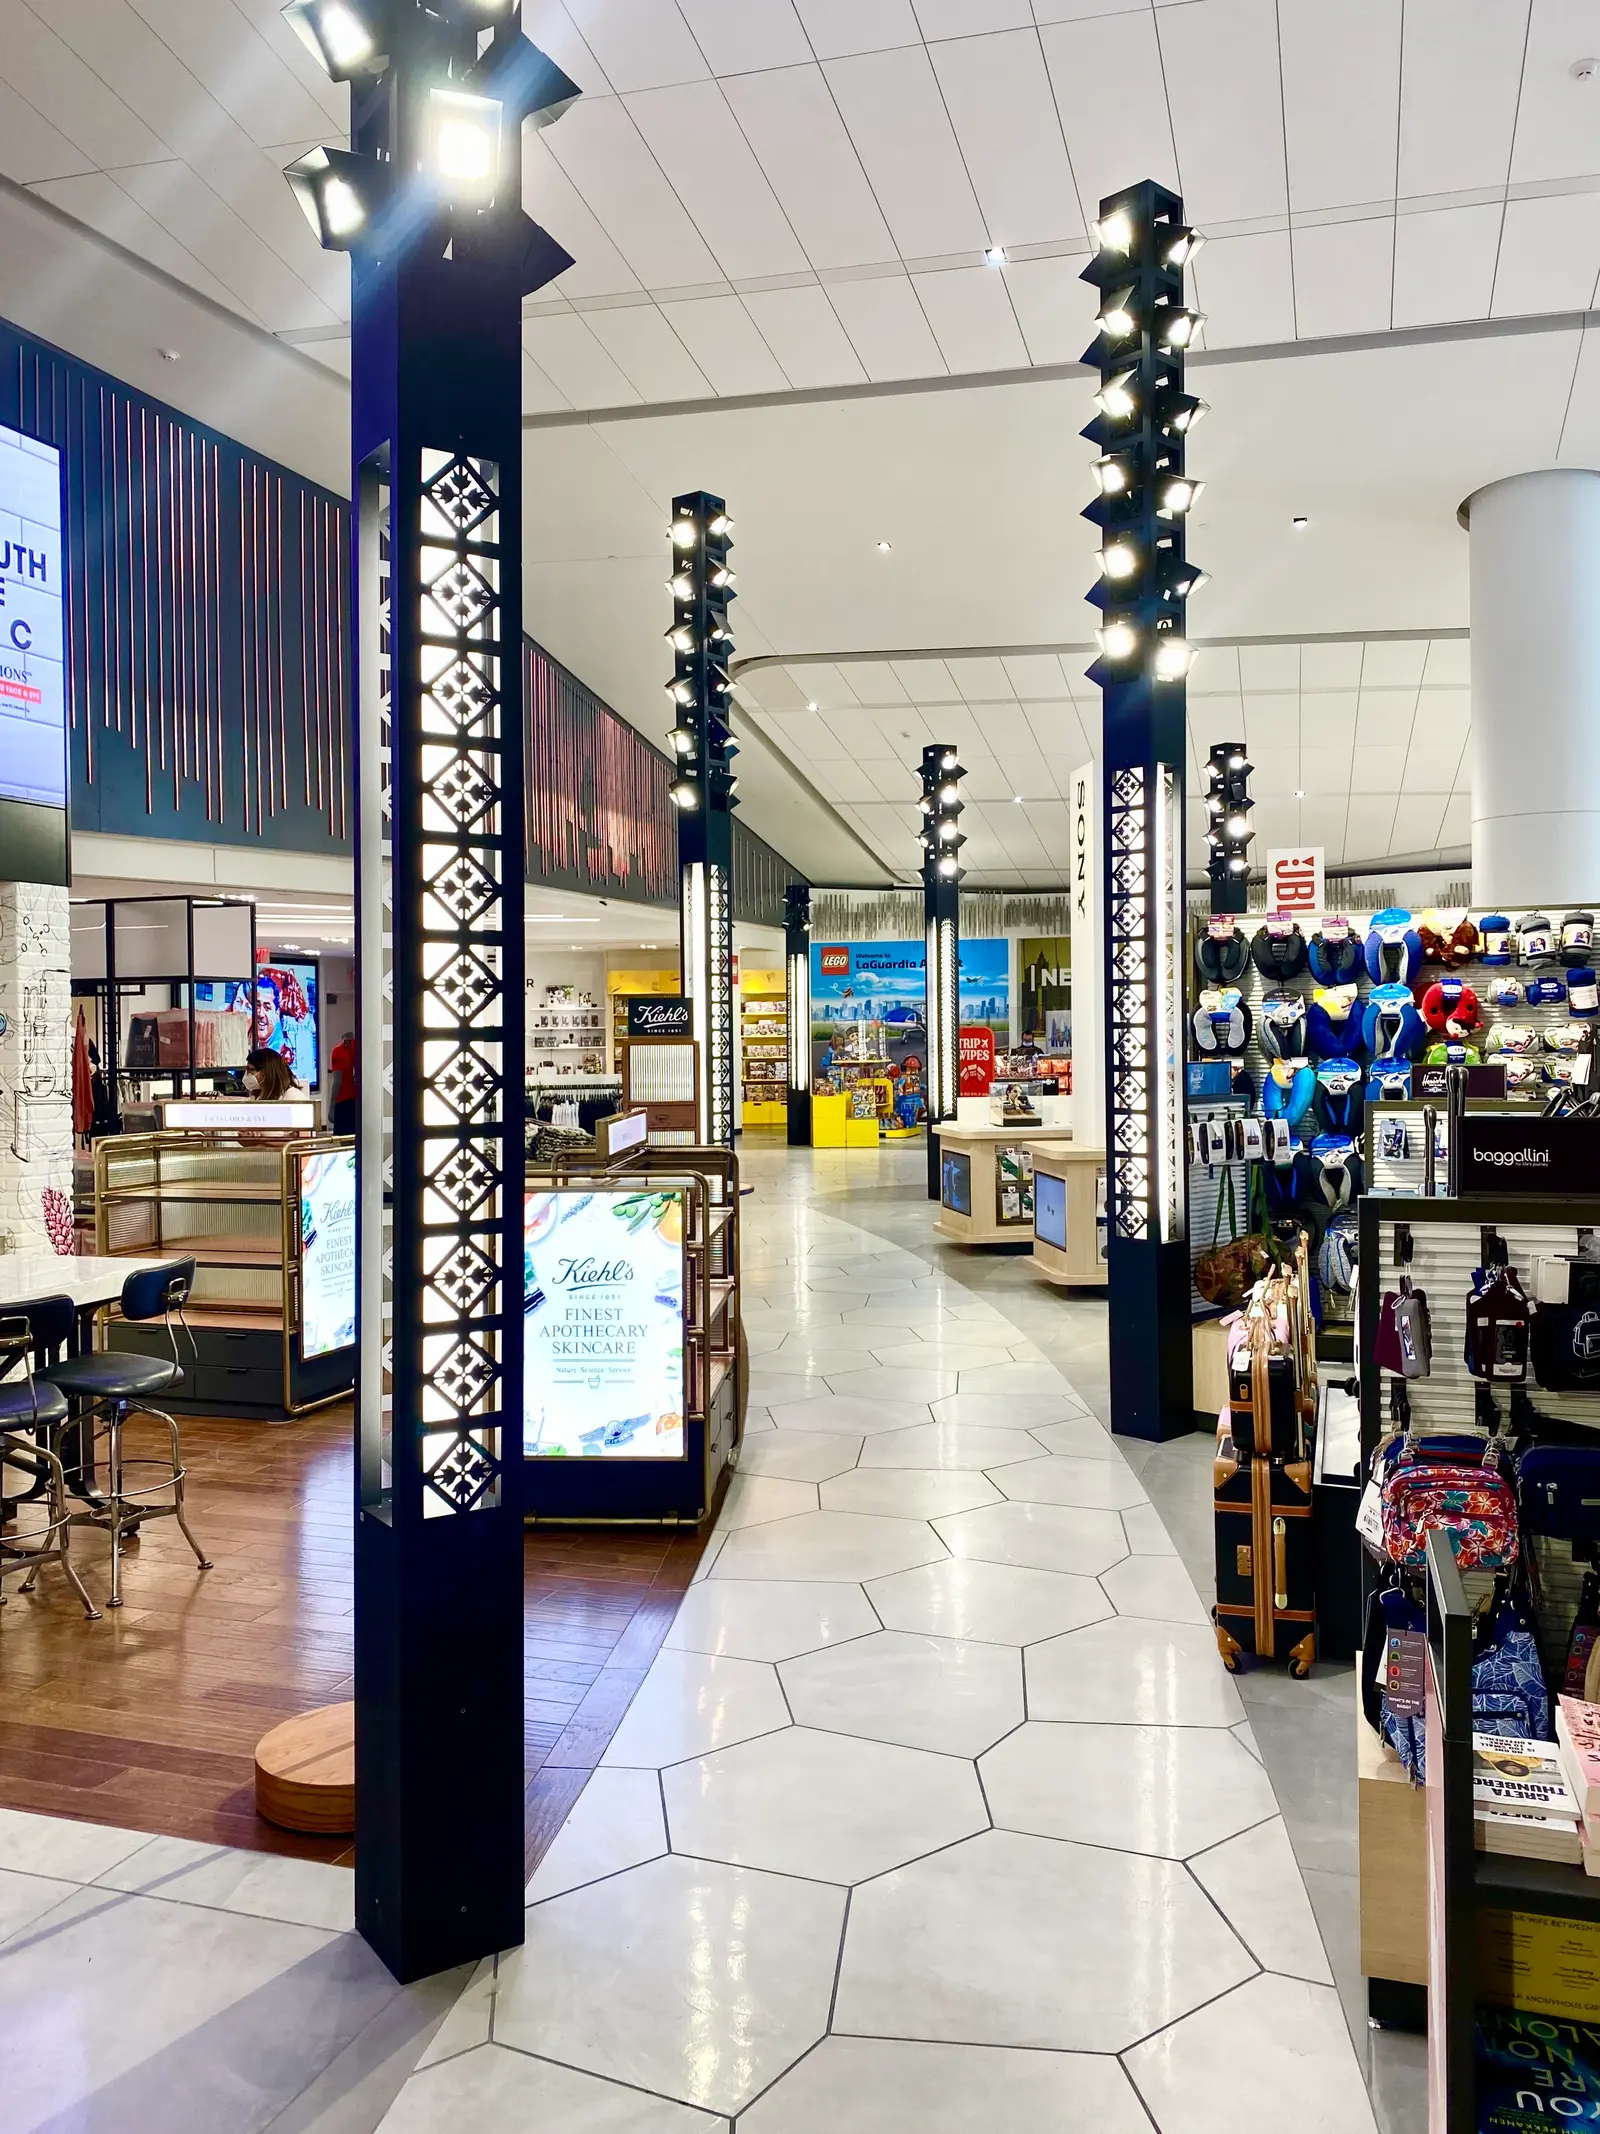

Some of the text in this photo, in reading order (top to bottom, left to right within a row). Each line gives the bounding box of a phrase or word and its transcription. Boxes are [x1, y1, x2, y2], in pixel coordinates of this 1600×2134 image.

[1077, 780, 1086, 919] SONY
[1275, 856, 1315, 914] JBL
[822, 954, 848, 968] LEGO
[855, 960, 917, 970] LaGuardia
[633, 1005, 689, 1024] Kiehl's
[1473, 1147, 1550, 1166] baggallini
[320, 1199, 355, 1224] Kiehl
[326, 1235, 353, 1250] FINEST
[315, 1248, 355, 1264] APOTHECA
[320, 1259, 354, 1276] SKINCAR
[551, 1257, 634, 1285] Kiehl's
[565, 1308, 624, 1321] FINEST
[539, 1324, 649, 1338] APOTHECARY
[552, 1341, 636, 1355] SKINCARE
[1491, 1788, 1550, 1802] GRETA
[1527, 1917, 1549, 1926] WIFE
[1551, 1920, 1593, 1932] BETWEEN
